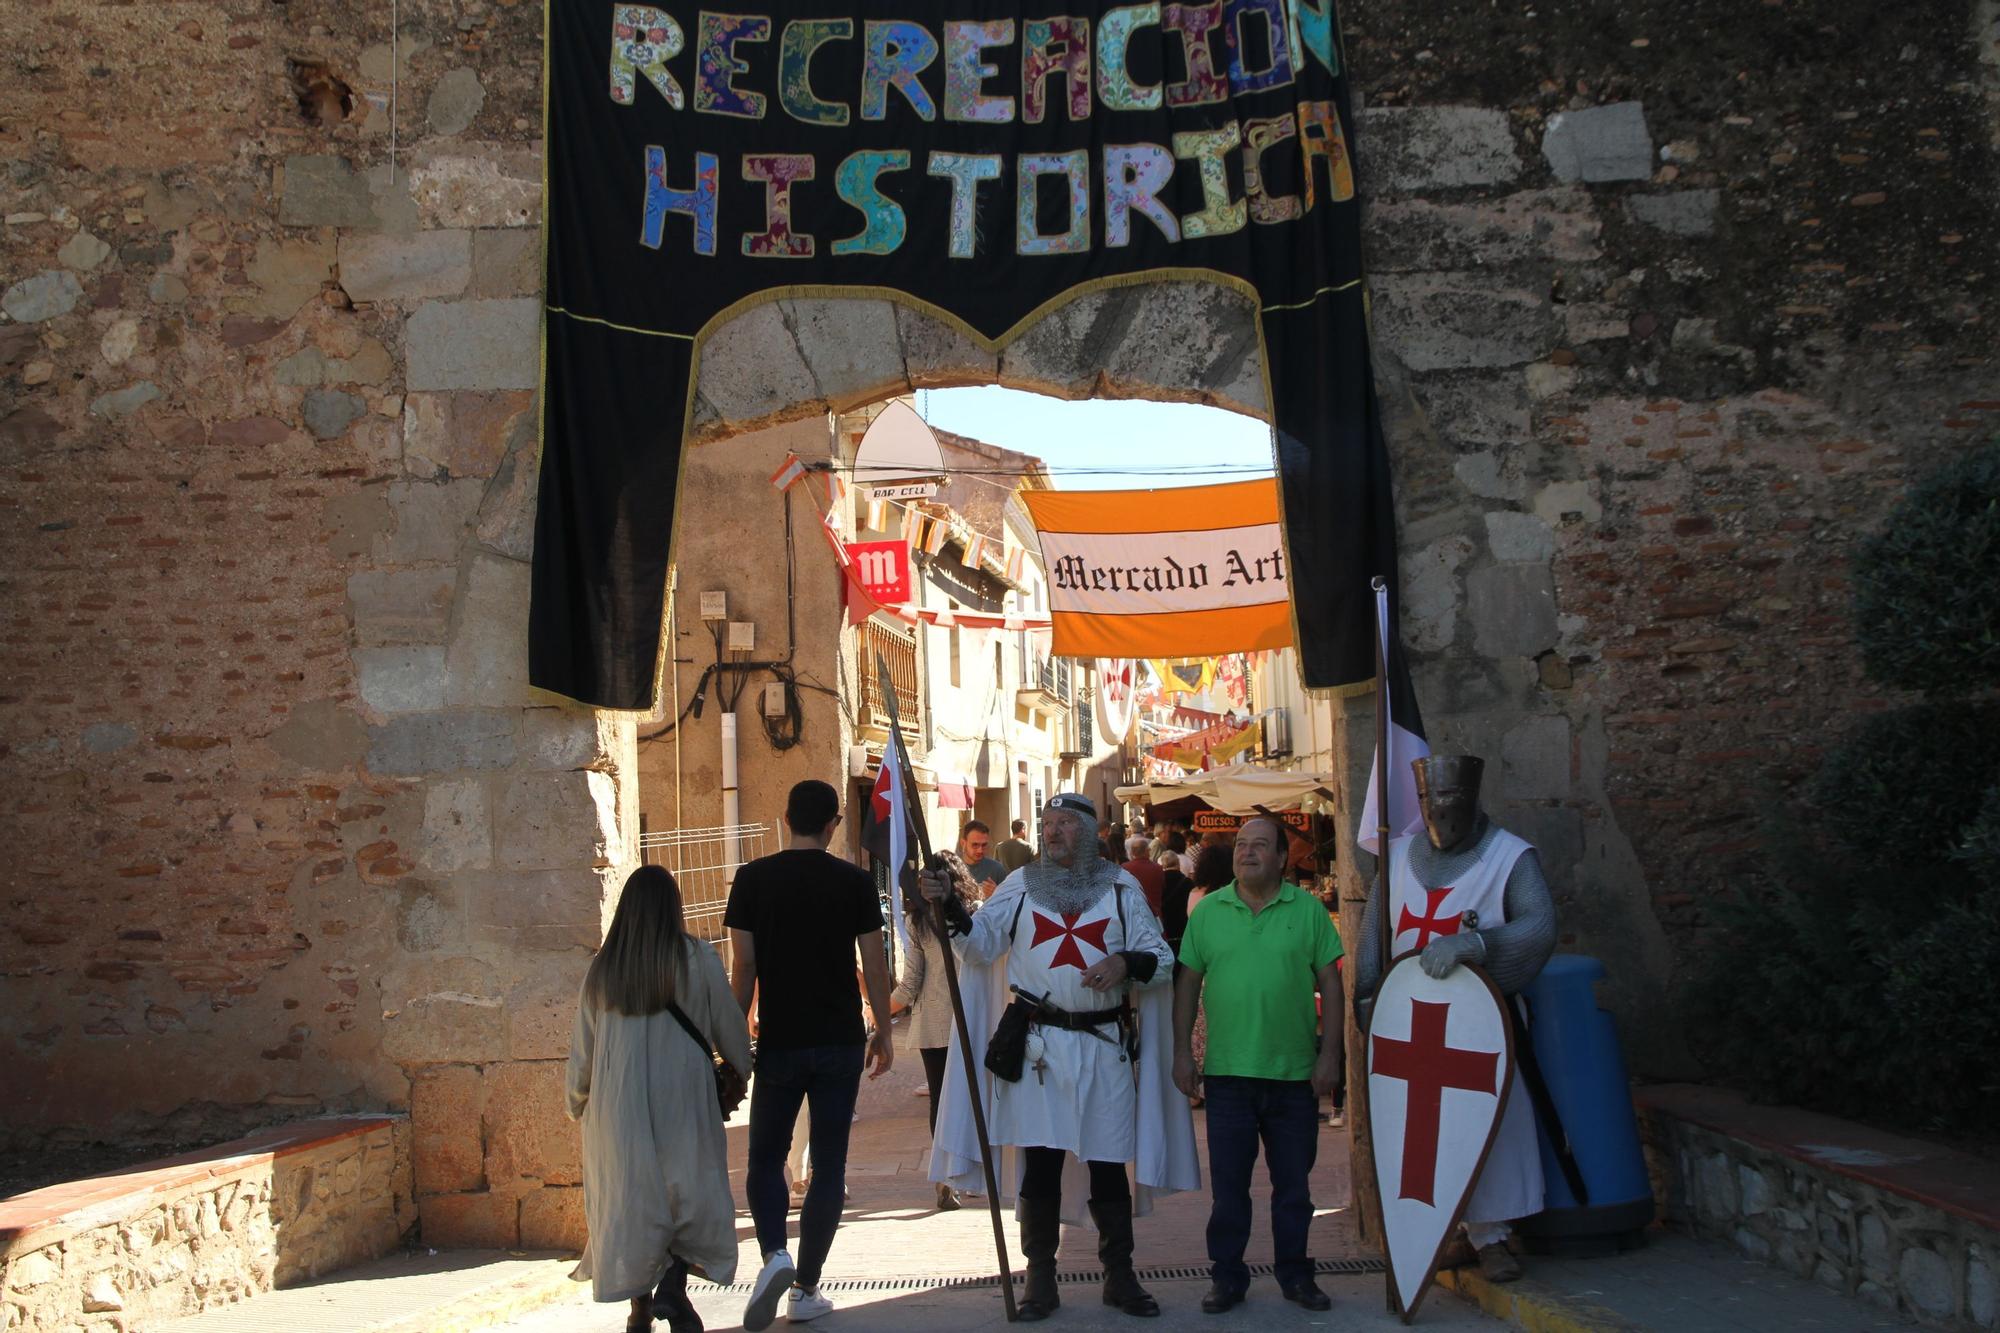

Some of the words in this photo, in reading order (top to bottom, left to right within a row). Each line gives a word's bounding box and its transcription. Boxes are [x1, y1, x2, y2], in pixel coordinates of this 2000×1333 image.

[639, 101, 1354, 259] HISTORICA
[873, 488, 896, 498] BAR
[1054, 554, 1209, 592] Mercado
